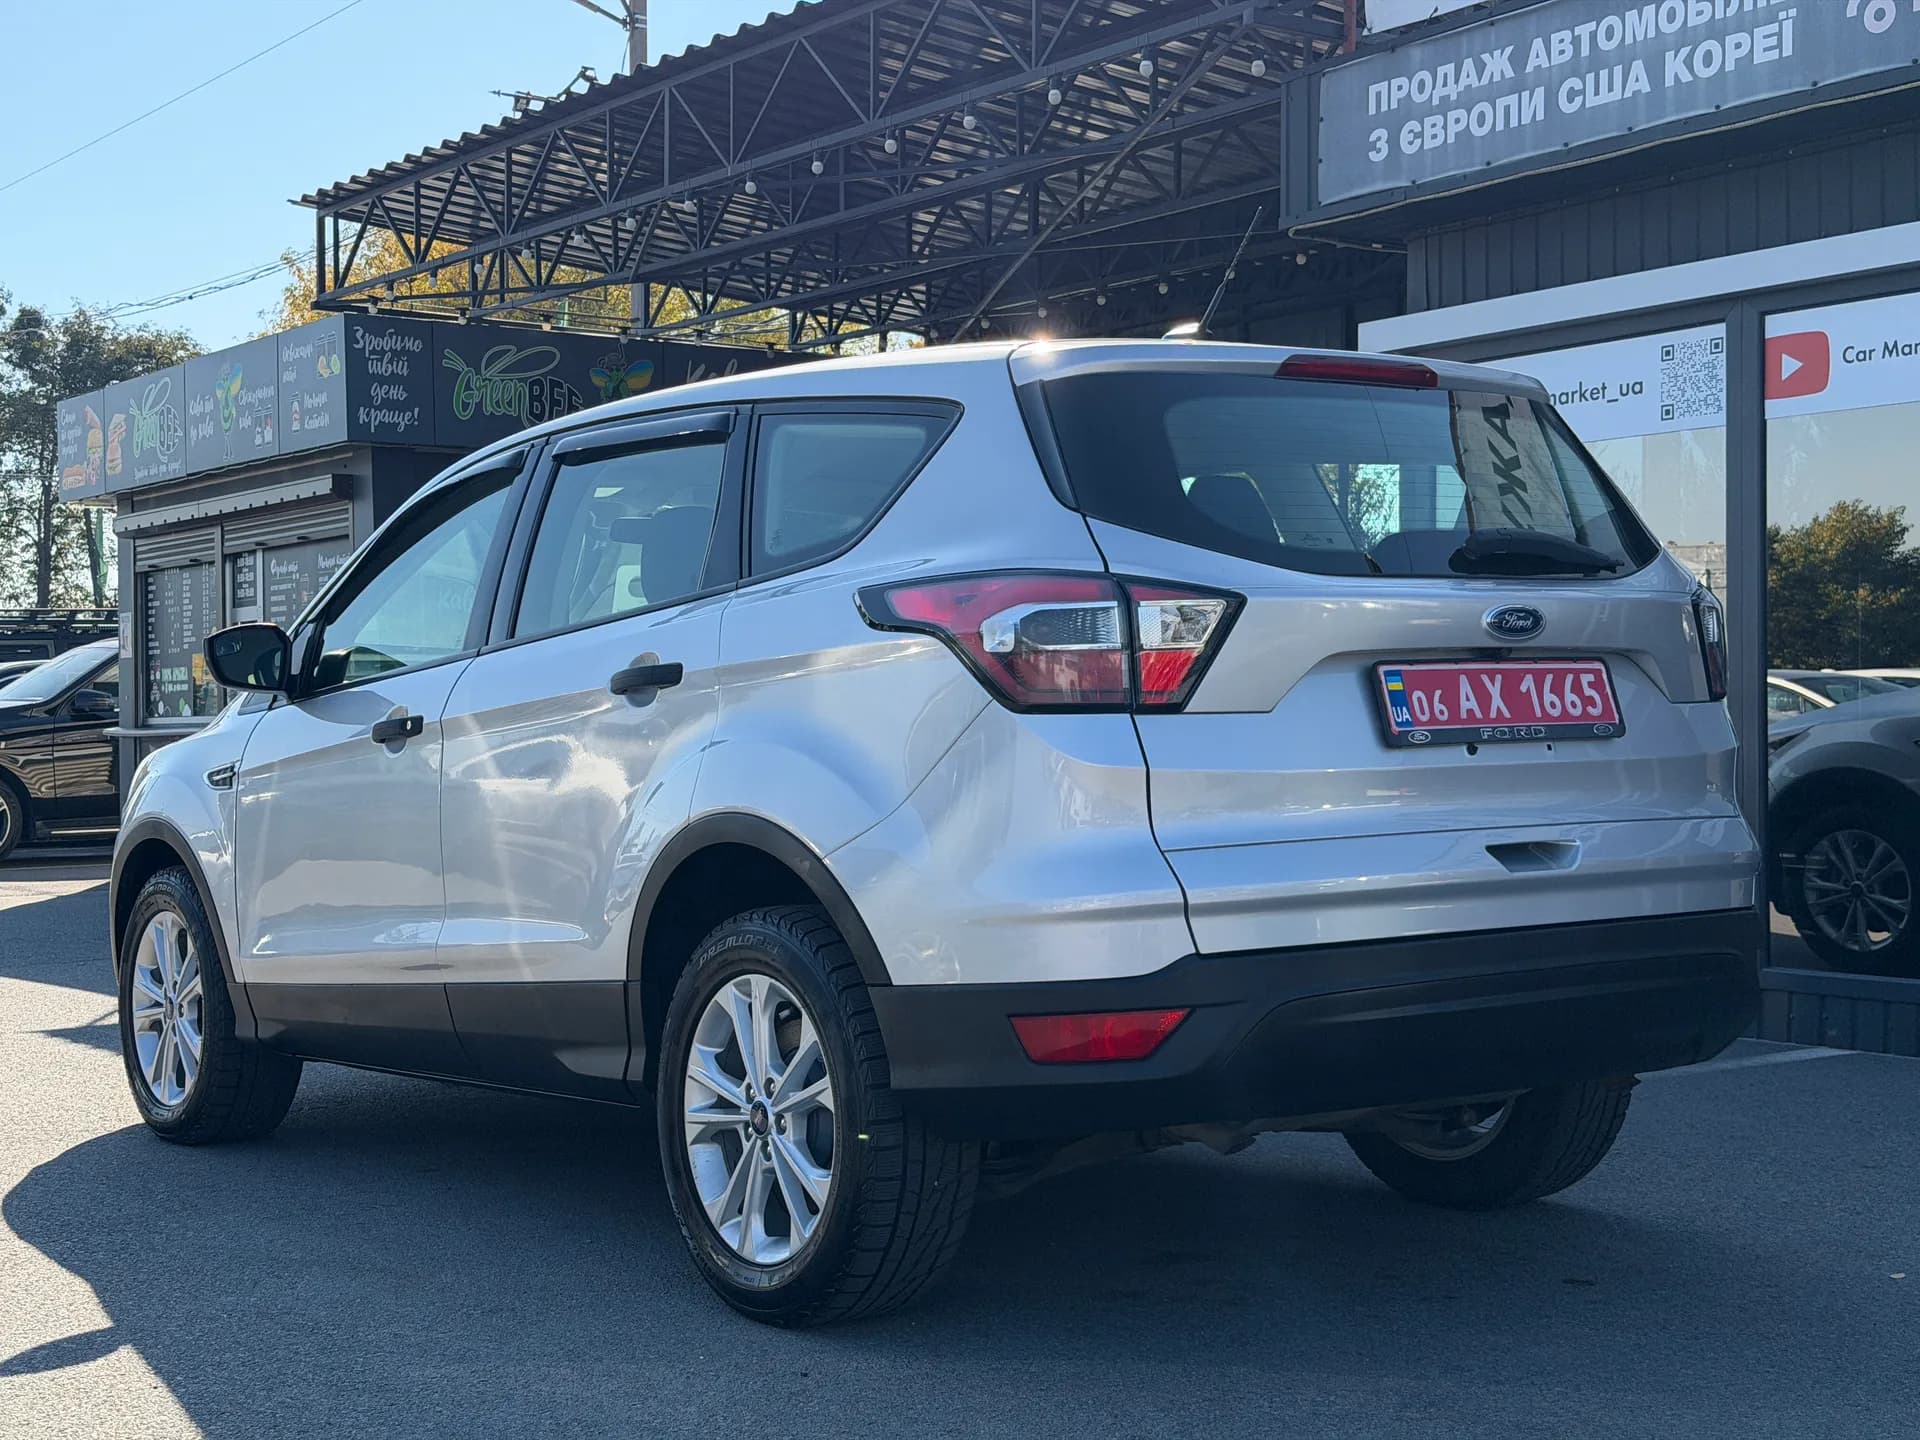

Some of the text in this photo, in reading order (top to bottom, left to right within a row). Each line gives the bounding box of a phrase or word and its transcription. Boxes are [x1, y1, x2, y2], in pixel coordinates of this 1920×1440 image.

[1368, 46, 1515, 116] ПРОДАЖ
[1399, 87, 1545, 154] ЄВРОПИ
[1557, 62, 1651, 115] США
[1664, 8, 1797, 88] КОРЕЇ
[353, 326, 423, 357] Зробимо
[367, 353, 410, 377] твій
[1842, 345, 1876, 364] Car
[370, 382, 408, 406] день
[357, 407, 419, 432] краще!
[1502, 611, 1534, 630] Ford
[1411, 673, 1603, 722] 06 AX 1665
[1392, 707, 1412, 723] UA
[1480, 726, 1547, 739] FORD
